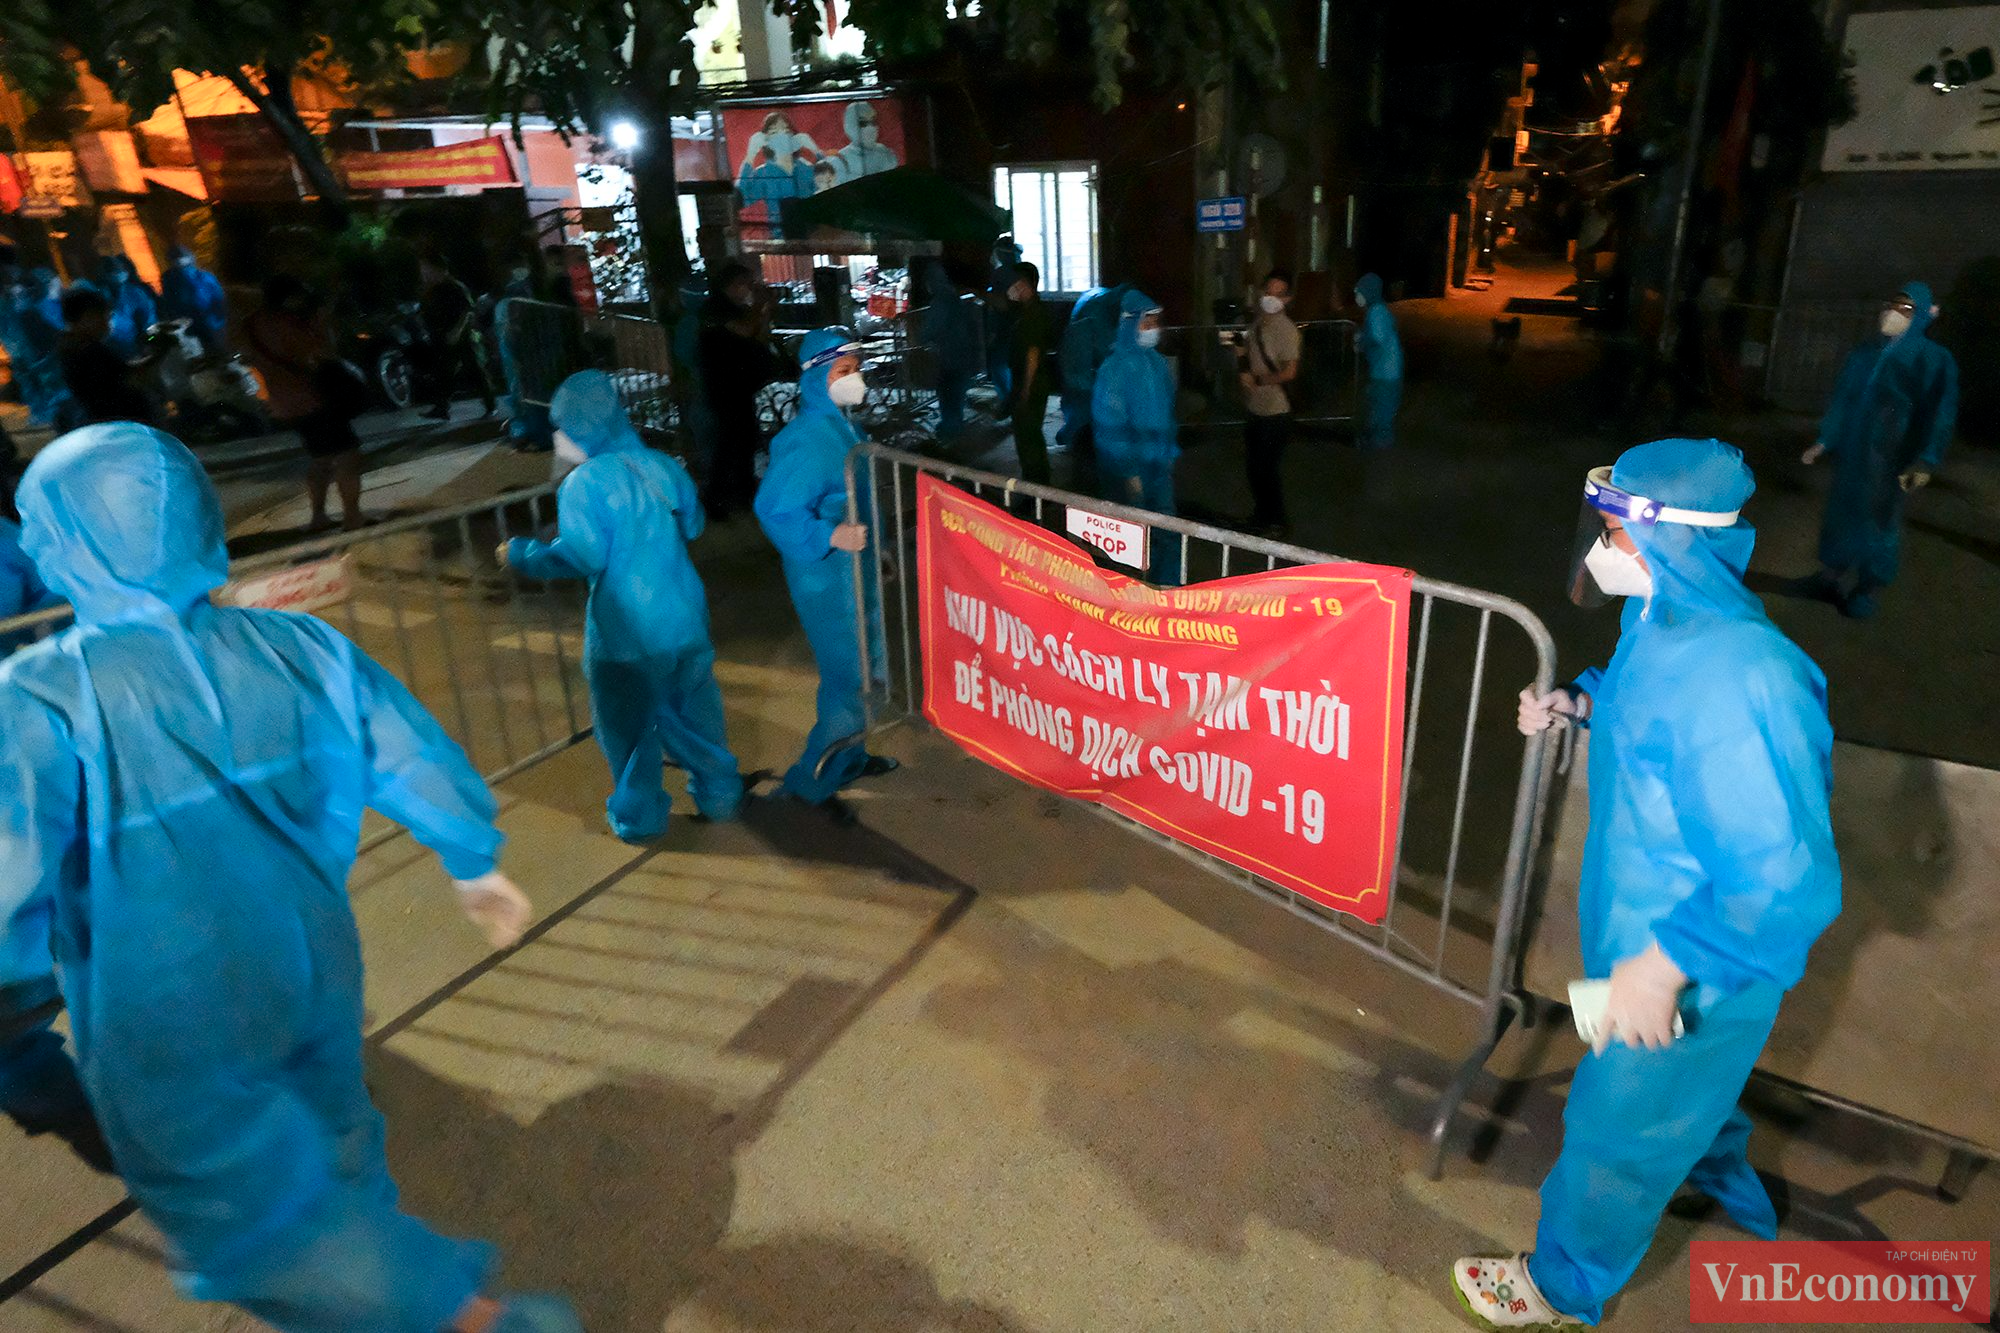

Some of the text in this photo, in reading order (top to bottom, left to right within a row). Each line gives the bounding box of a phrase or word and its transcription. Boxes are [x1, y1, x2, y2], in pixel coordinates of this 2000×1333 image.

[1086, 516, 1122, 533] POLICE
[1082, 530, 1127, 555] STOP
[1173, 589, 1223, 614] DỊCH
[1225, 592, 1287, 618] COVID
[1311, 596, 1343, 617] 19
[1167, 617, 1239, 645] TRUNG
[944, 585, 1350, 761] KHU VỰC CÁCH LY TẠM THỜI
[954, 652, 985, 712] ĐỂ
[989, 676, 1075, 755] PHÒNG
[1079, 715, 1144, 781] DỊCH
[1149, 746, 1252, 817] COVID
